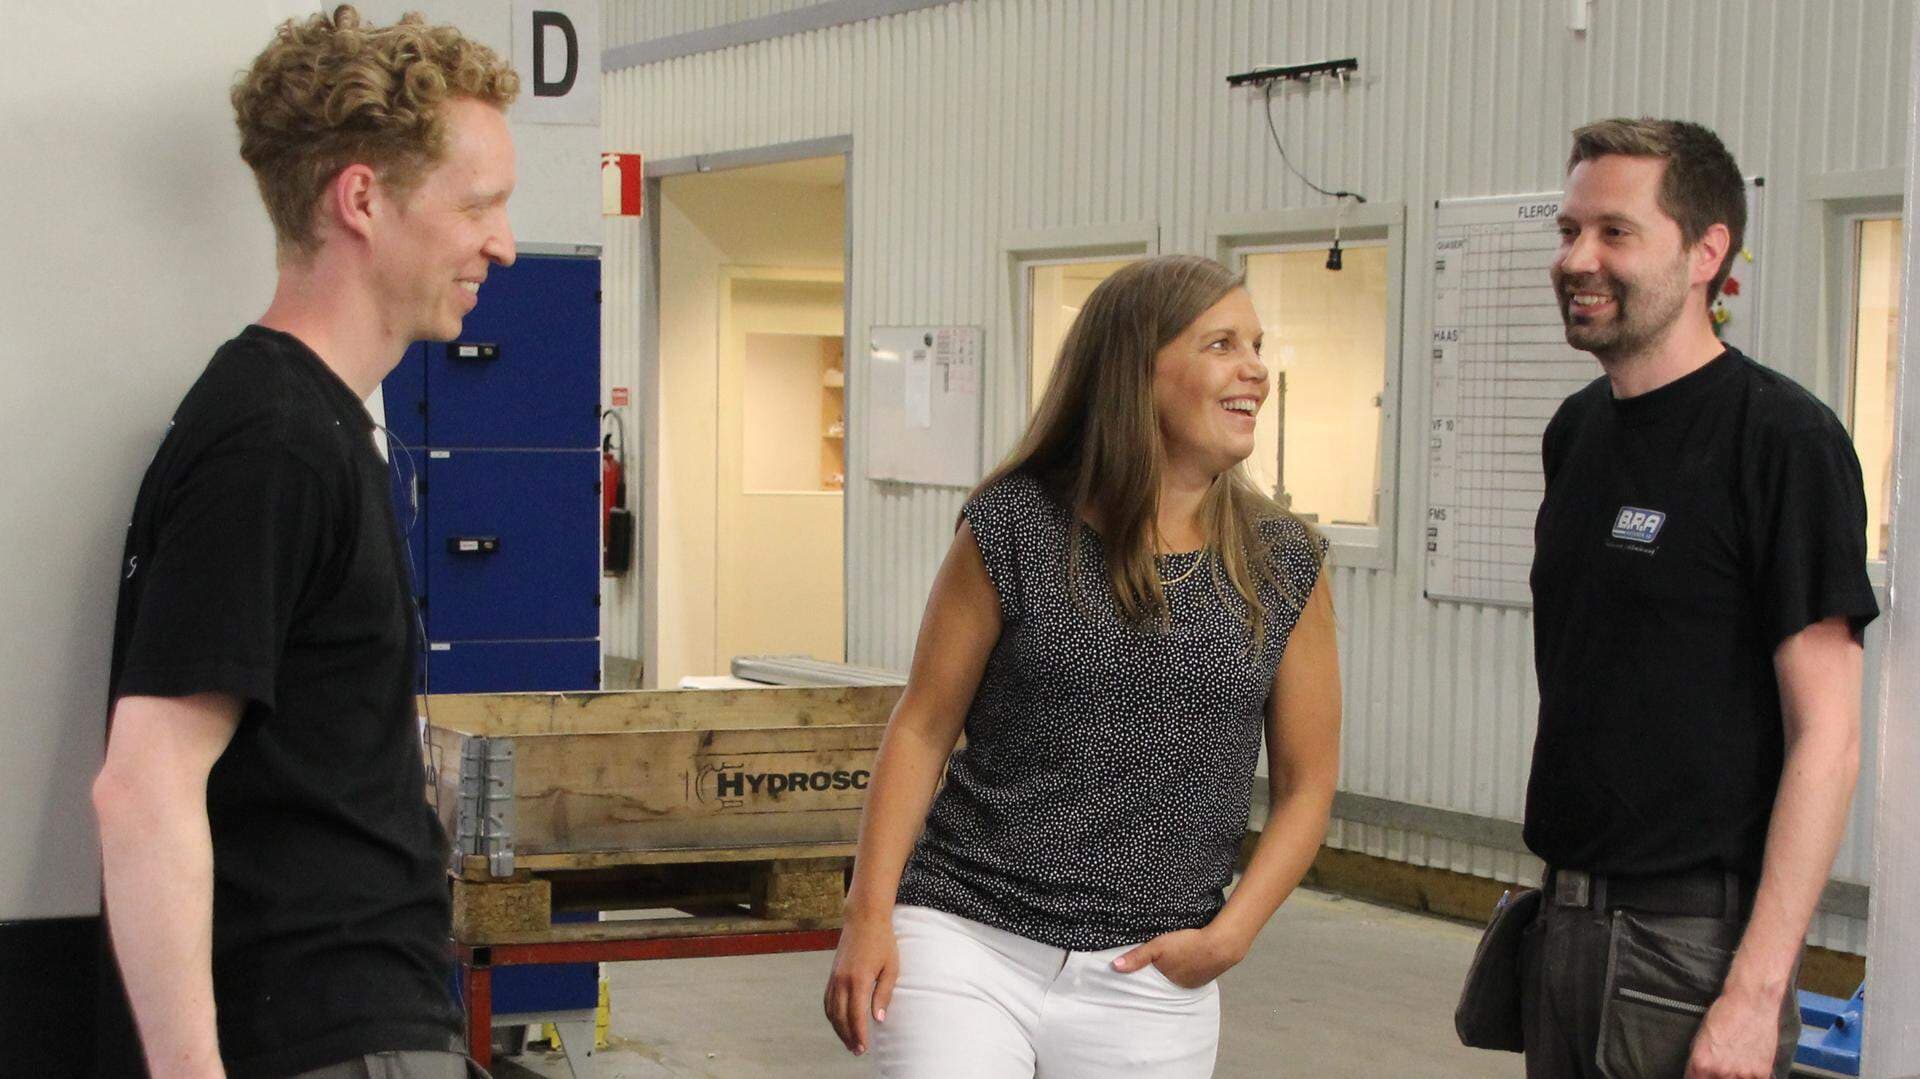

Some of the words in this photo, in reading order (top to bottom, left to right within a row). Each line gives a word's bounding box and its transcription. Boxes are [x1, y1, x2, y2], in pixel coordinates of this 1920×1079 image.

[532, 10, 579, 97] D
[1433, 329, 1458, 342] HAAS
[1617, 509, 1661, 533] BRA
[716, 769, 871, 798] HYDROSC
